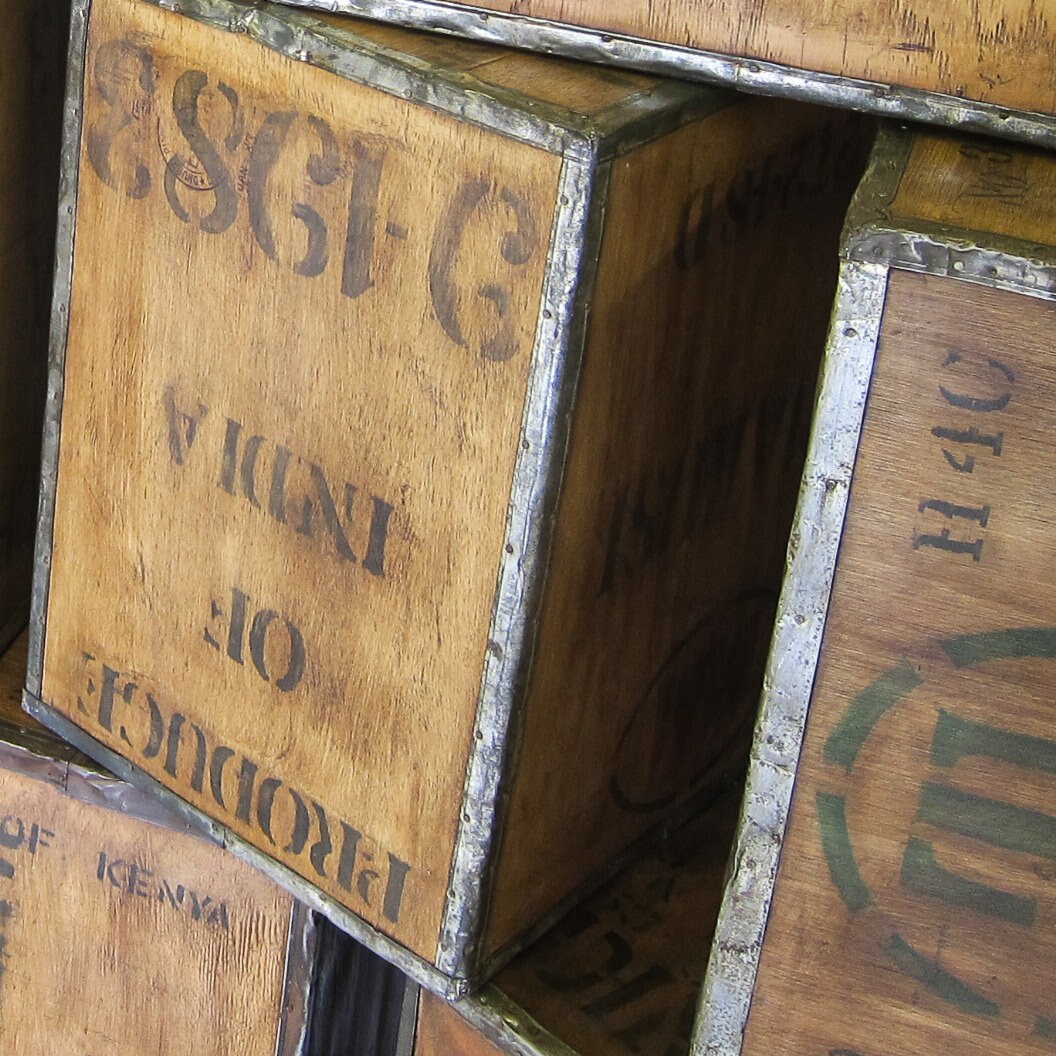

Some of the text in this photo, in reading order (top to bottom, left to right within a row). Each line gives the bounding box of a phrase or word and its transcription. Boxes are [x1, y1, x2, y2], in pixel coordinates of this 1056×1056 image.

[162, 383, 398, 580] INDIA
[203, 586, 308, 695] OF
[78, 653, 411, 926] PRODUCE
[98, 850, 230, 931] KENYA
